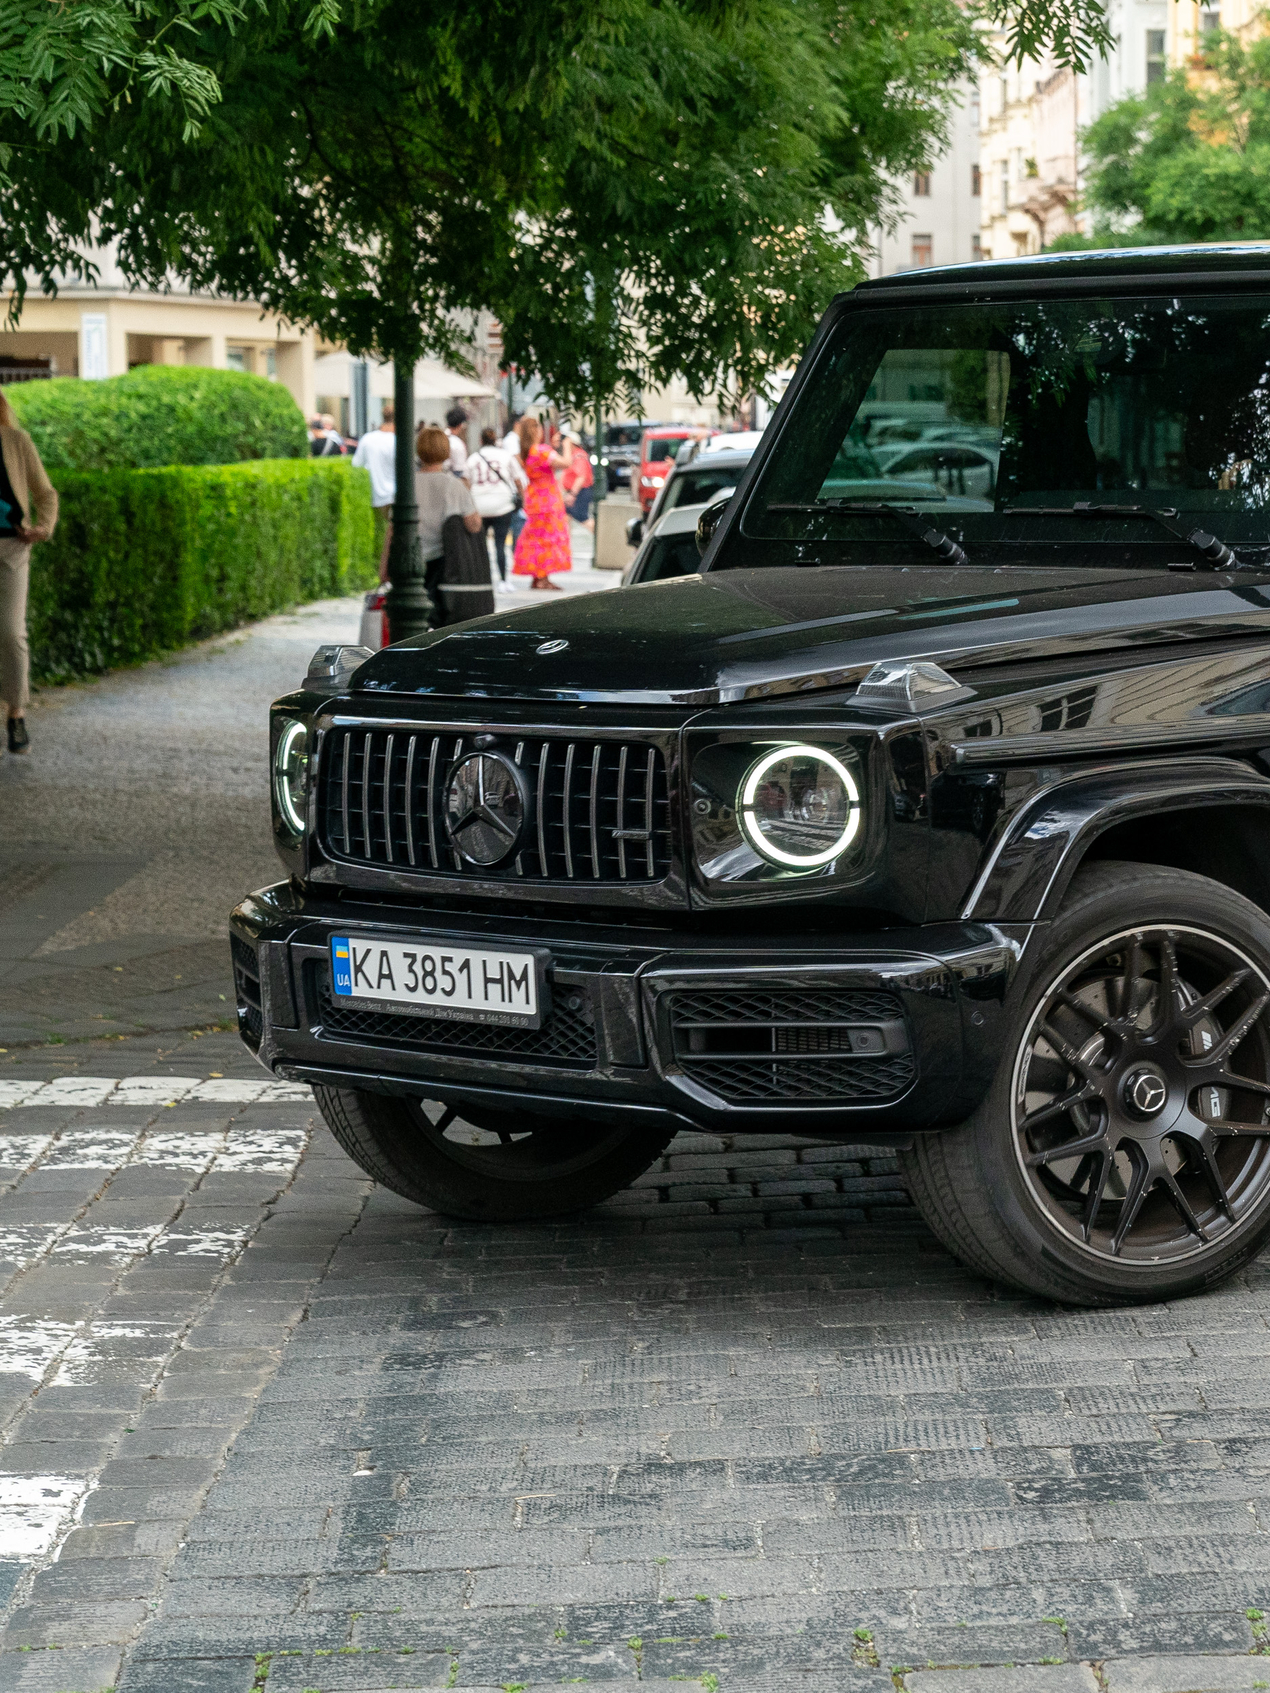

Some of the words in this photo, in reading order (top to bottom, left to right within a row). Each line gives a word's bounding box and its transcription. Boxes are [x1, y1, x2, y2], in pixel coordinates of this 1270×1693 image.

[336, 973, 350, 987] UA
[352, 947, 396, 991] KA
[403, 952, 472, 999] 3851
[482, 959, 530, 1005] HM
